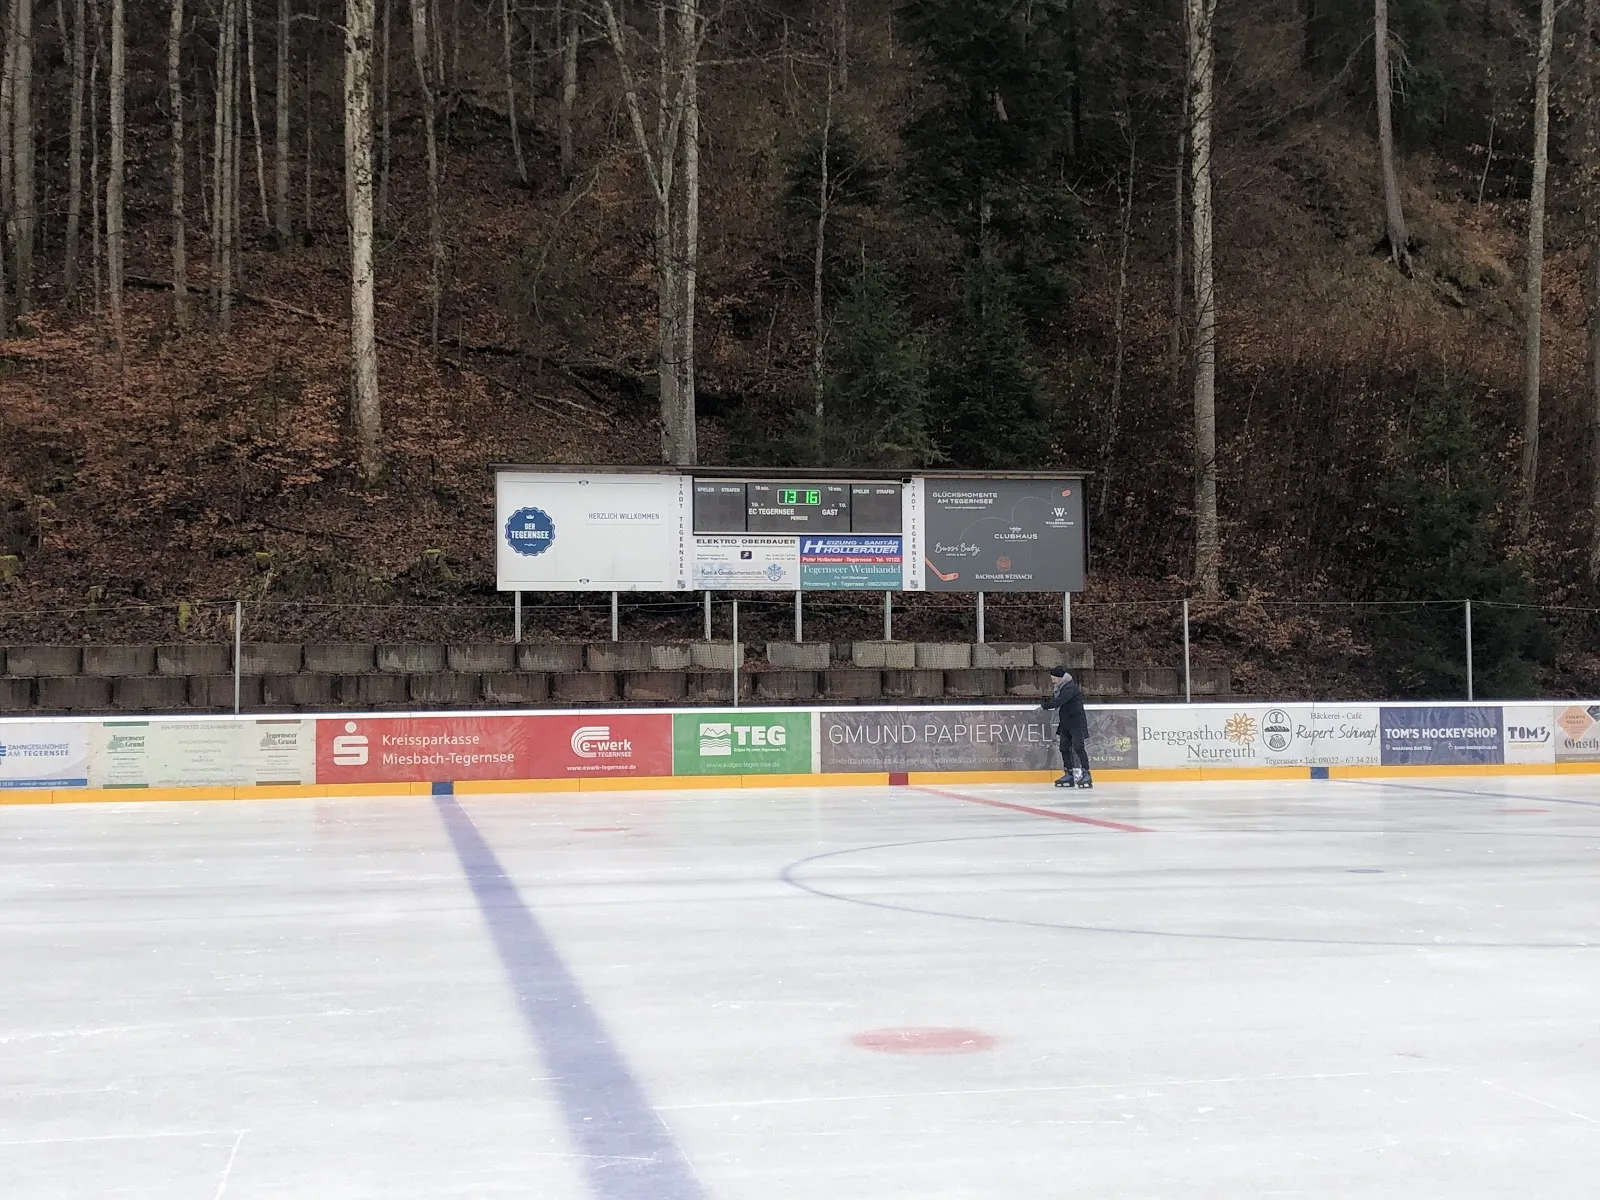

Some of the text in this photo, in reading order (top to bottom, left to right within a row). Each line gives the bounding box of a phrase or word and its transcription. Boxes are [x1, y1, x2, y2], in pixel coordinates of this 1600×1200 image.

[784, 491, 818, 504] 13 16
[588, 512, 660, 520] HERZLICH WILLKOMMEN
[510, 530, 550, 539] TEGERNSEE
[801, 564, 901, 574] Tegernseer Weinhandel
[733, 725, 786, 746] TEG
[828, 723, 1060, 744] GMUND PAPIERWEL
[1142, 724, 1229, 746] Berggasthof
[1296, 724, 1334, 746] Rupert
[1385, 727, 1498, 738] TOM'S HOCKEYSHOP
[382, 733, 480, 747] Kreissparkasse
[582, 738, 632, 751] e-werk
[8, 743, 69, 751] ZAHNGESUNDHEIT
[23, 749, 69, 757] TEGERNSEE
[1187, 742, 1256, 758] Neureuth
[382, 752, 515, 766] Miesbach-Tegernsee
